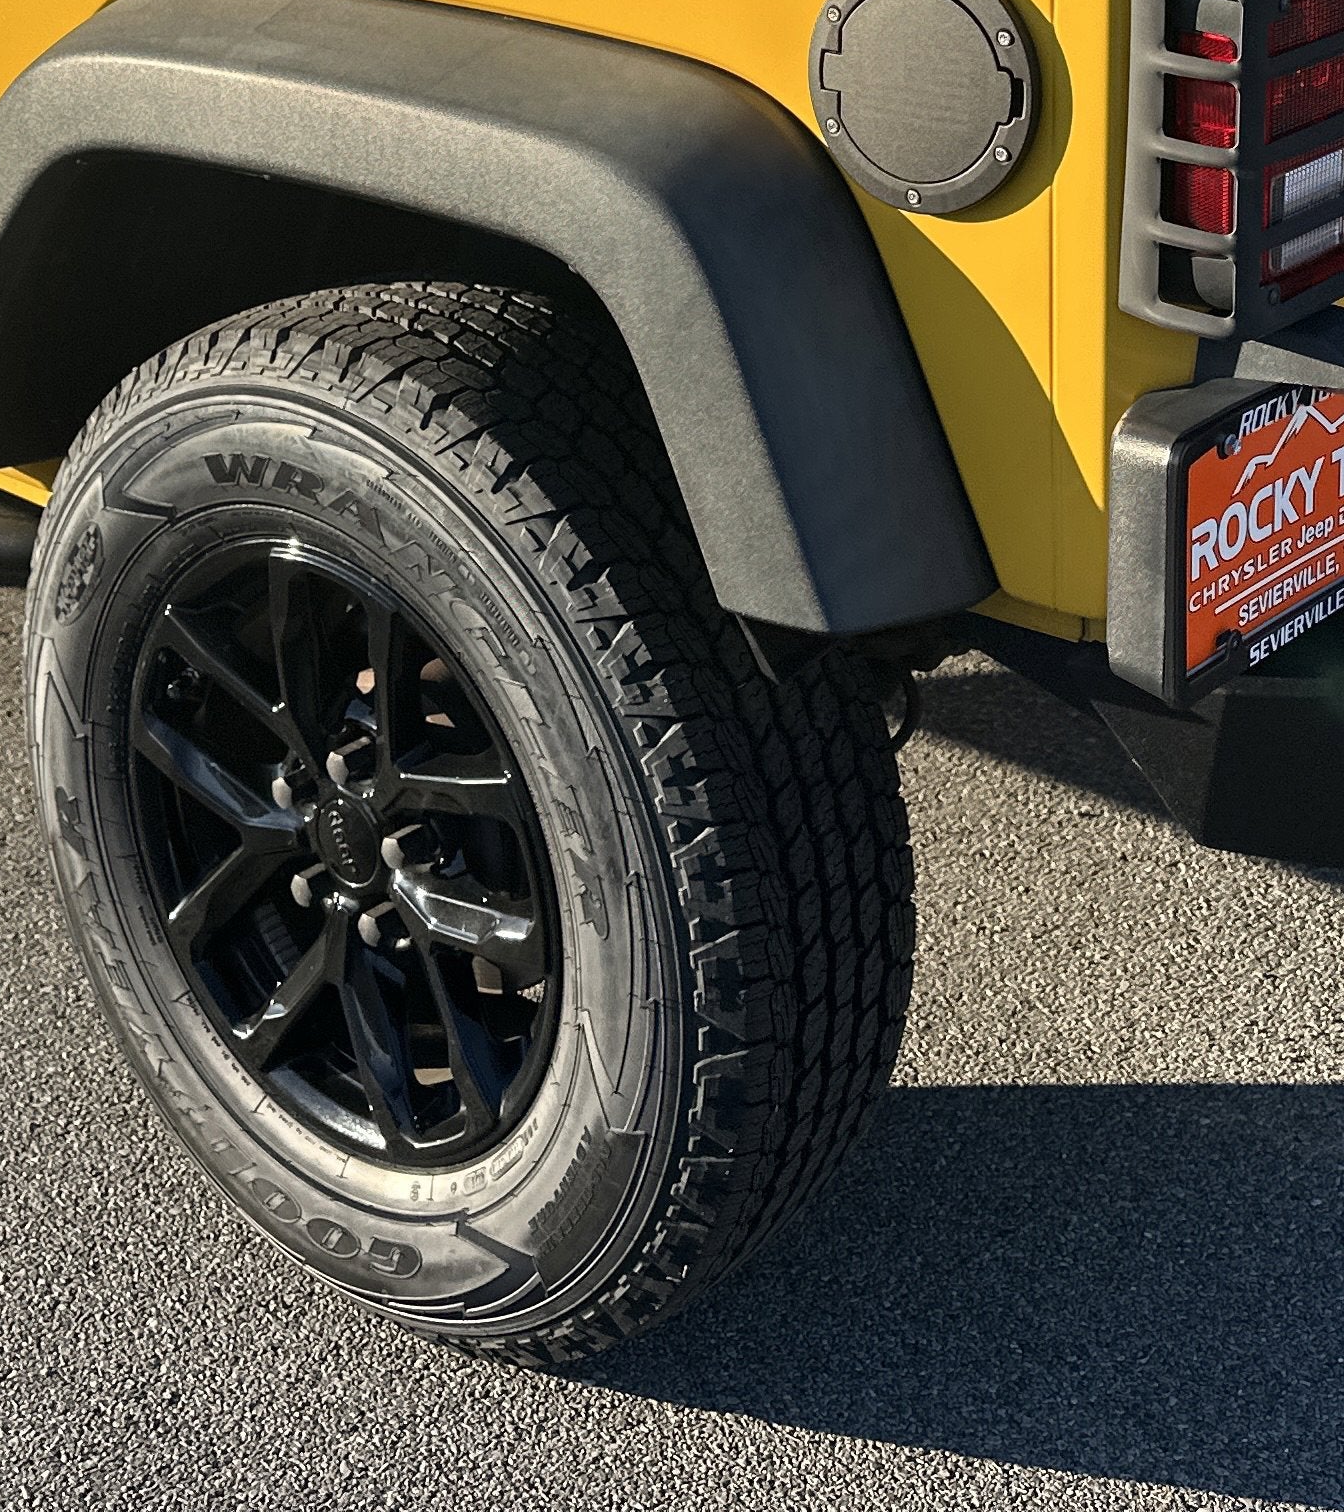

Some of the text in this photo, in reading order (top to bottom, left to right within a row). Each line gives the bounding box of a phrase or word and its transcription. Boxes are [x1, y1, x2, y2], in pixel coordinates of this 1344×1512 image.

[1189, 538, 1293, 612] CHRYSLER
[1296, 515, 1334, 549] Jeep
[1191, 456, 1325, 581] ROCKY
[1238, 552, 1340, 627] SEVIERVILLE,
